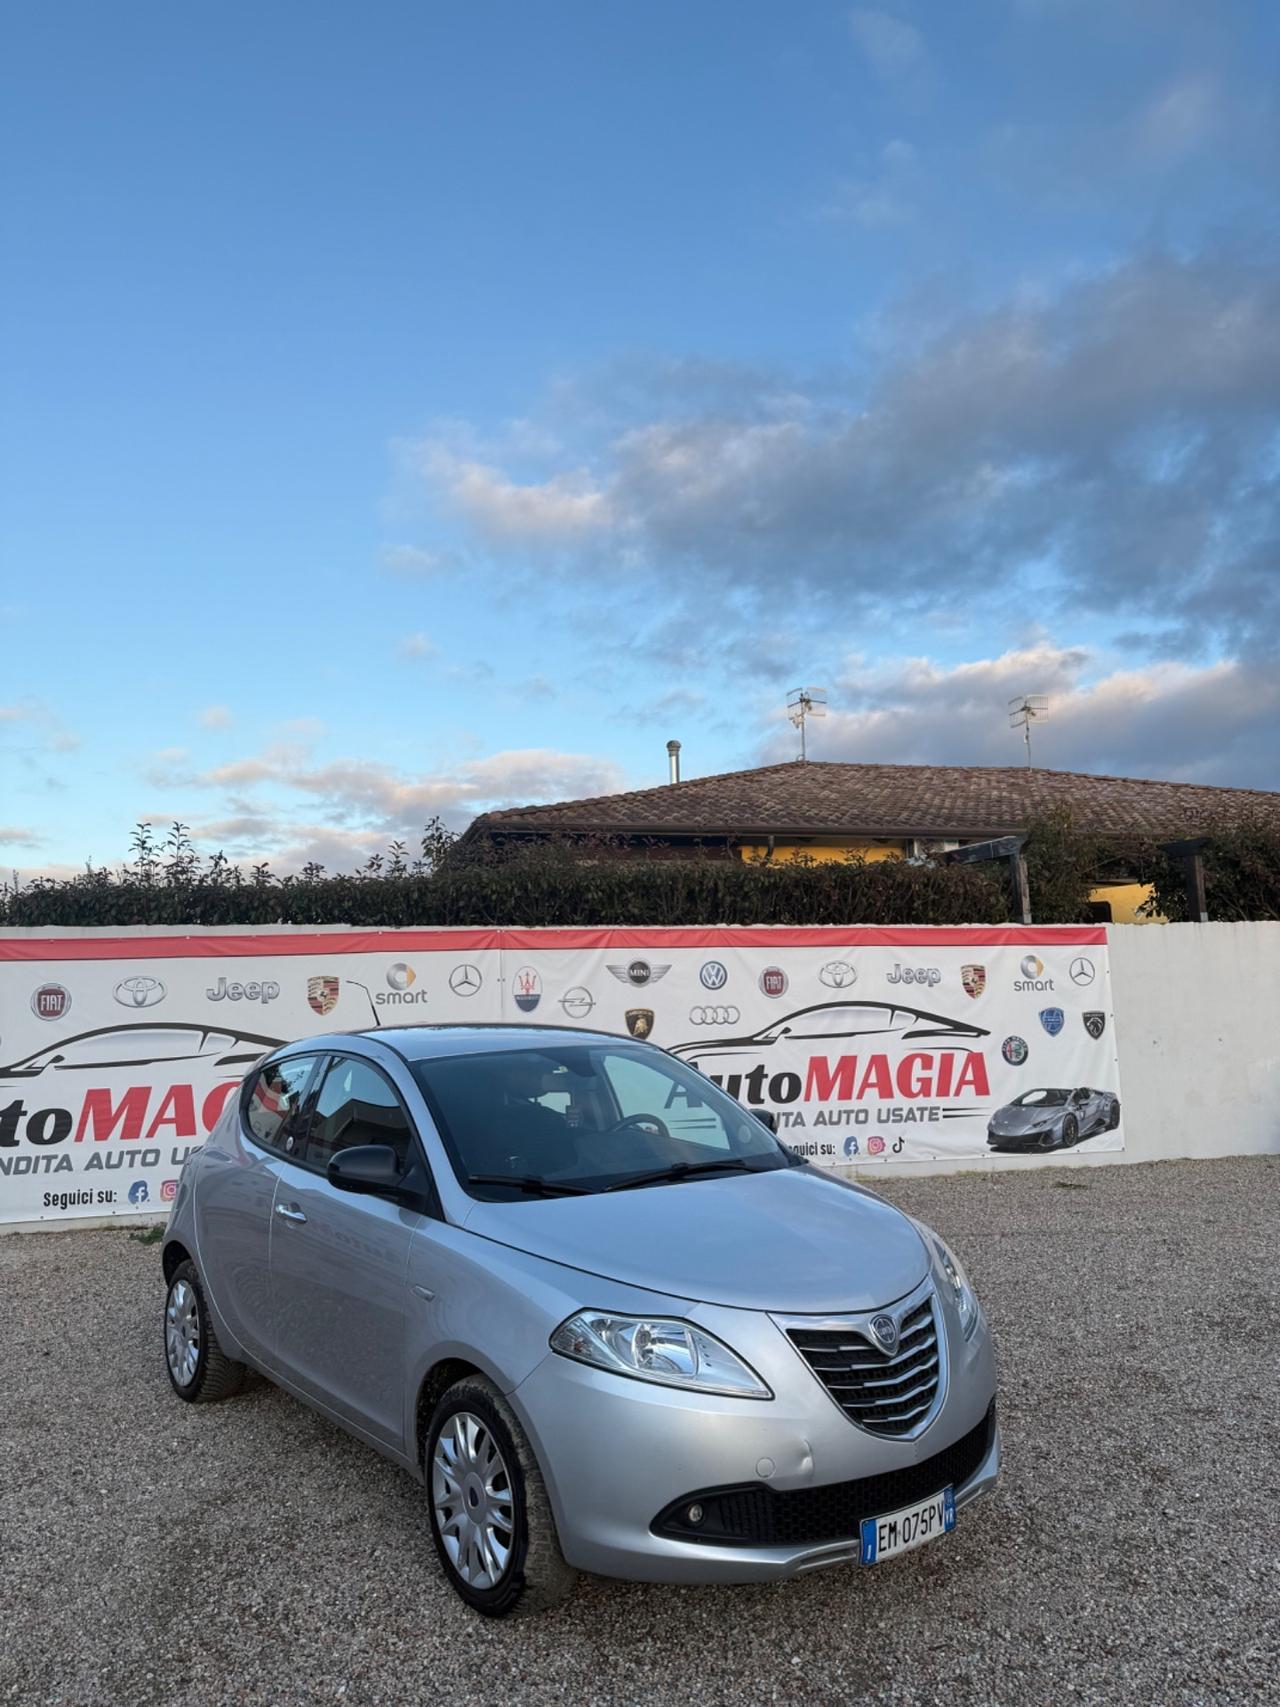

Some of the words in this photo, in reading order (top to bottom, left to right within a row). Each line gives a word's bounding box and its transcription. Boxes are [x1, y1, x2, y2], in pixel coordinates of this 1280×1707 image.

[630, 968, 650, 977] MINI
[887, 964, 941, 987] Jeep
[206, 976, 281, 1004] Jeep
[766, 975, 783, 991] FIAT
[1014, 979, 1055, 992] smart
[40, 994, 62, 1011] FIAT
[375, 989, 428, 1005] smart
[813, 1108, 869, 1127] AUTO
[877, 1106, 941, 1123] USATE
[84, 1148, 161, 1171] AUTO
[820, 1144, 836, 1156] su:
[43, 1188, 93, 1210] Seguici
[97, 1189, 117, 1204] su:
[902, 1501, 944, 1544] 075PV
